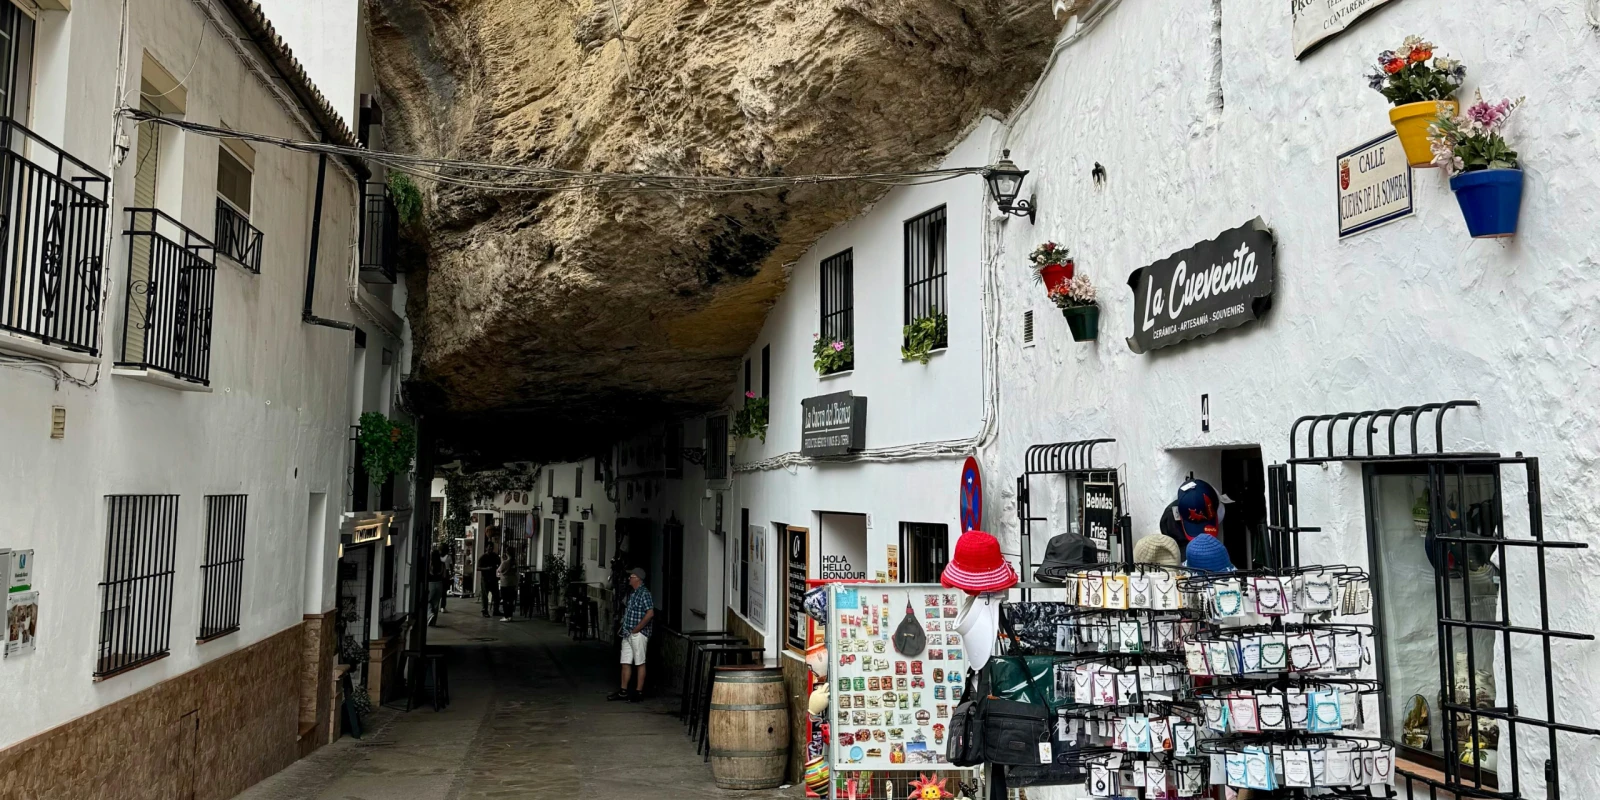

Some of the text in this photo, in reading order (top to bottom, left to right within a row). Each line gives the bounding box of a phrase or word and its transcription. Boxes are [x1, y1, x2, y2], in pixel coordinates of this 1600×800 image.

[1359, 147, 1386, 173] CALLE
[1341, 172, 1408, 220] CUEVAS DE LA SOMBRA
[1142, 241, 1259, 332] La Cuevecita
[1153, 324, 1177, 340] CERÁMICA
[1180, 312, 1209, 331] ARTESANÍA
[1212, 303, 1245, 321] SOUVENIRS
[1202, 397, 1209, 426] 4
[1086, 492, 1113, 510] Bebidas
[1090, 521, 1107, 539] Frías
[822, 555, 848, 563] HOLA
[822, 563, 852, 571] HELLO
[822, 571, 866, 579] BONJOUR
